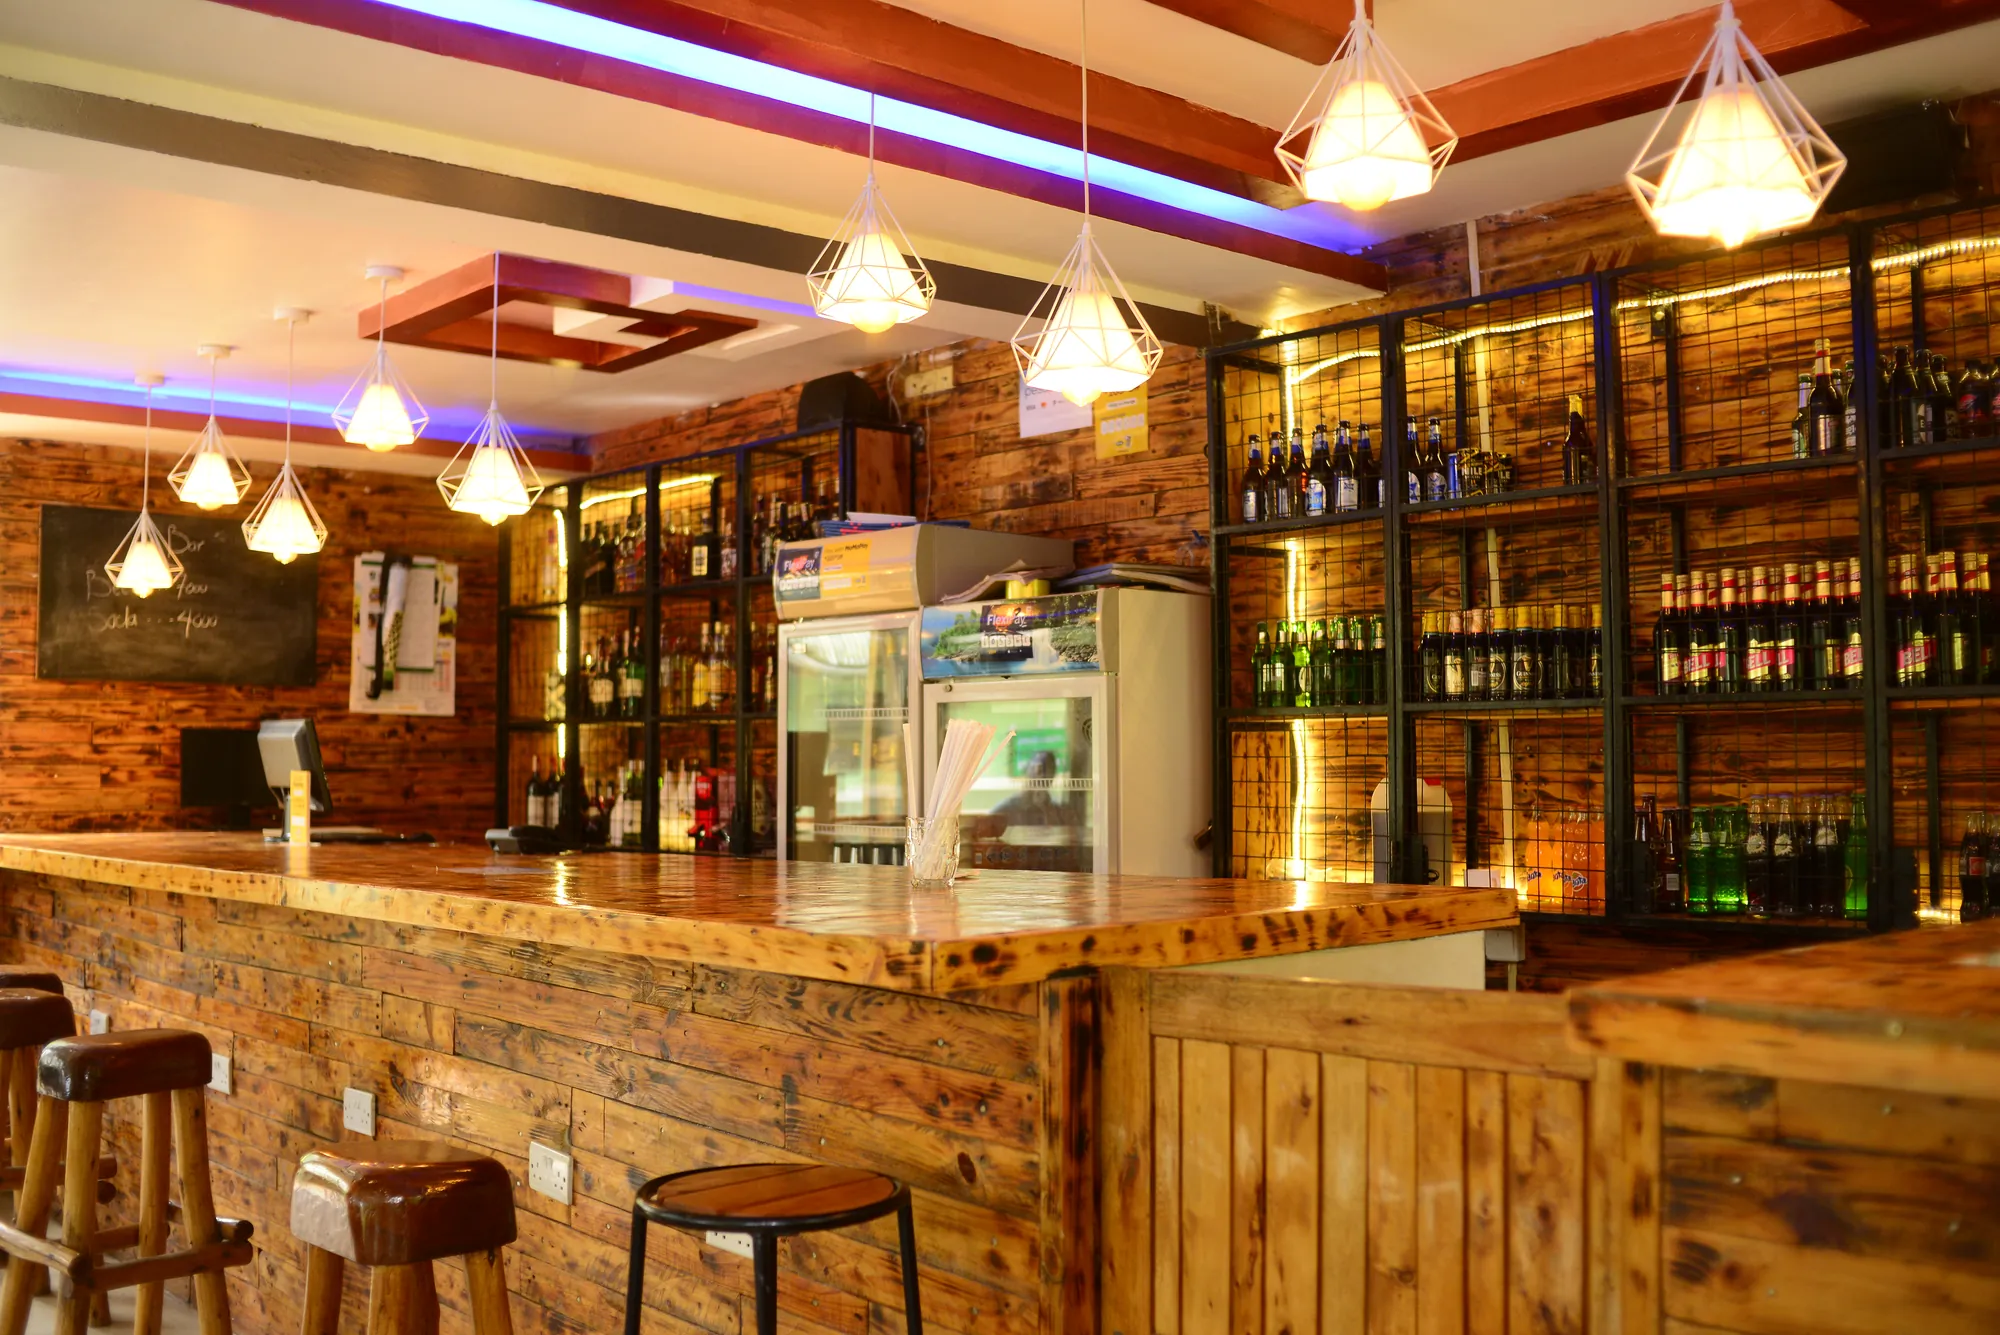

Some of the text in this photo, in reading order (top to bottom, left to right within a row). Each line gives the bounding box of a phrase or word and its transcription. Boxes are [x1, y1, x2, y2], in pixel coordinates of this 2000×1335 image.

[1462, 467, 1482, 476] NILE
[167, 524, 205, 558] Bar
[1746, 650, 1771, 669] ELL
